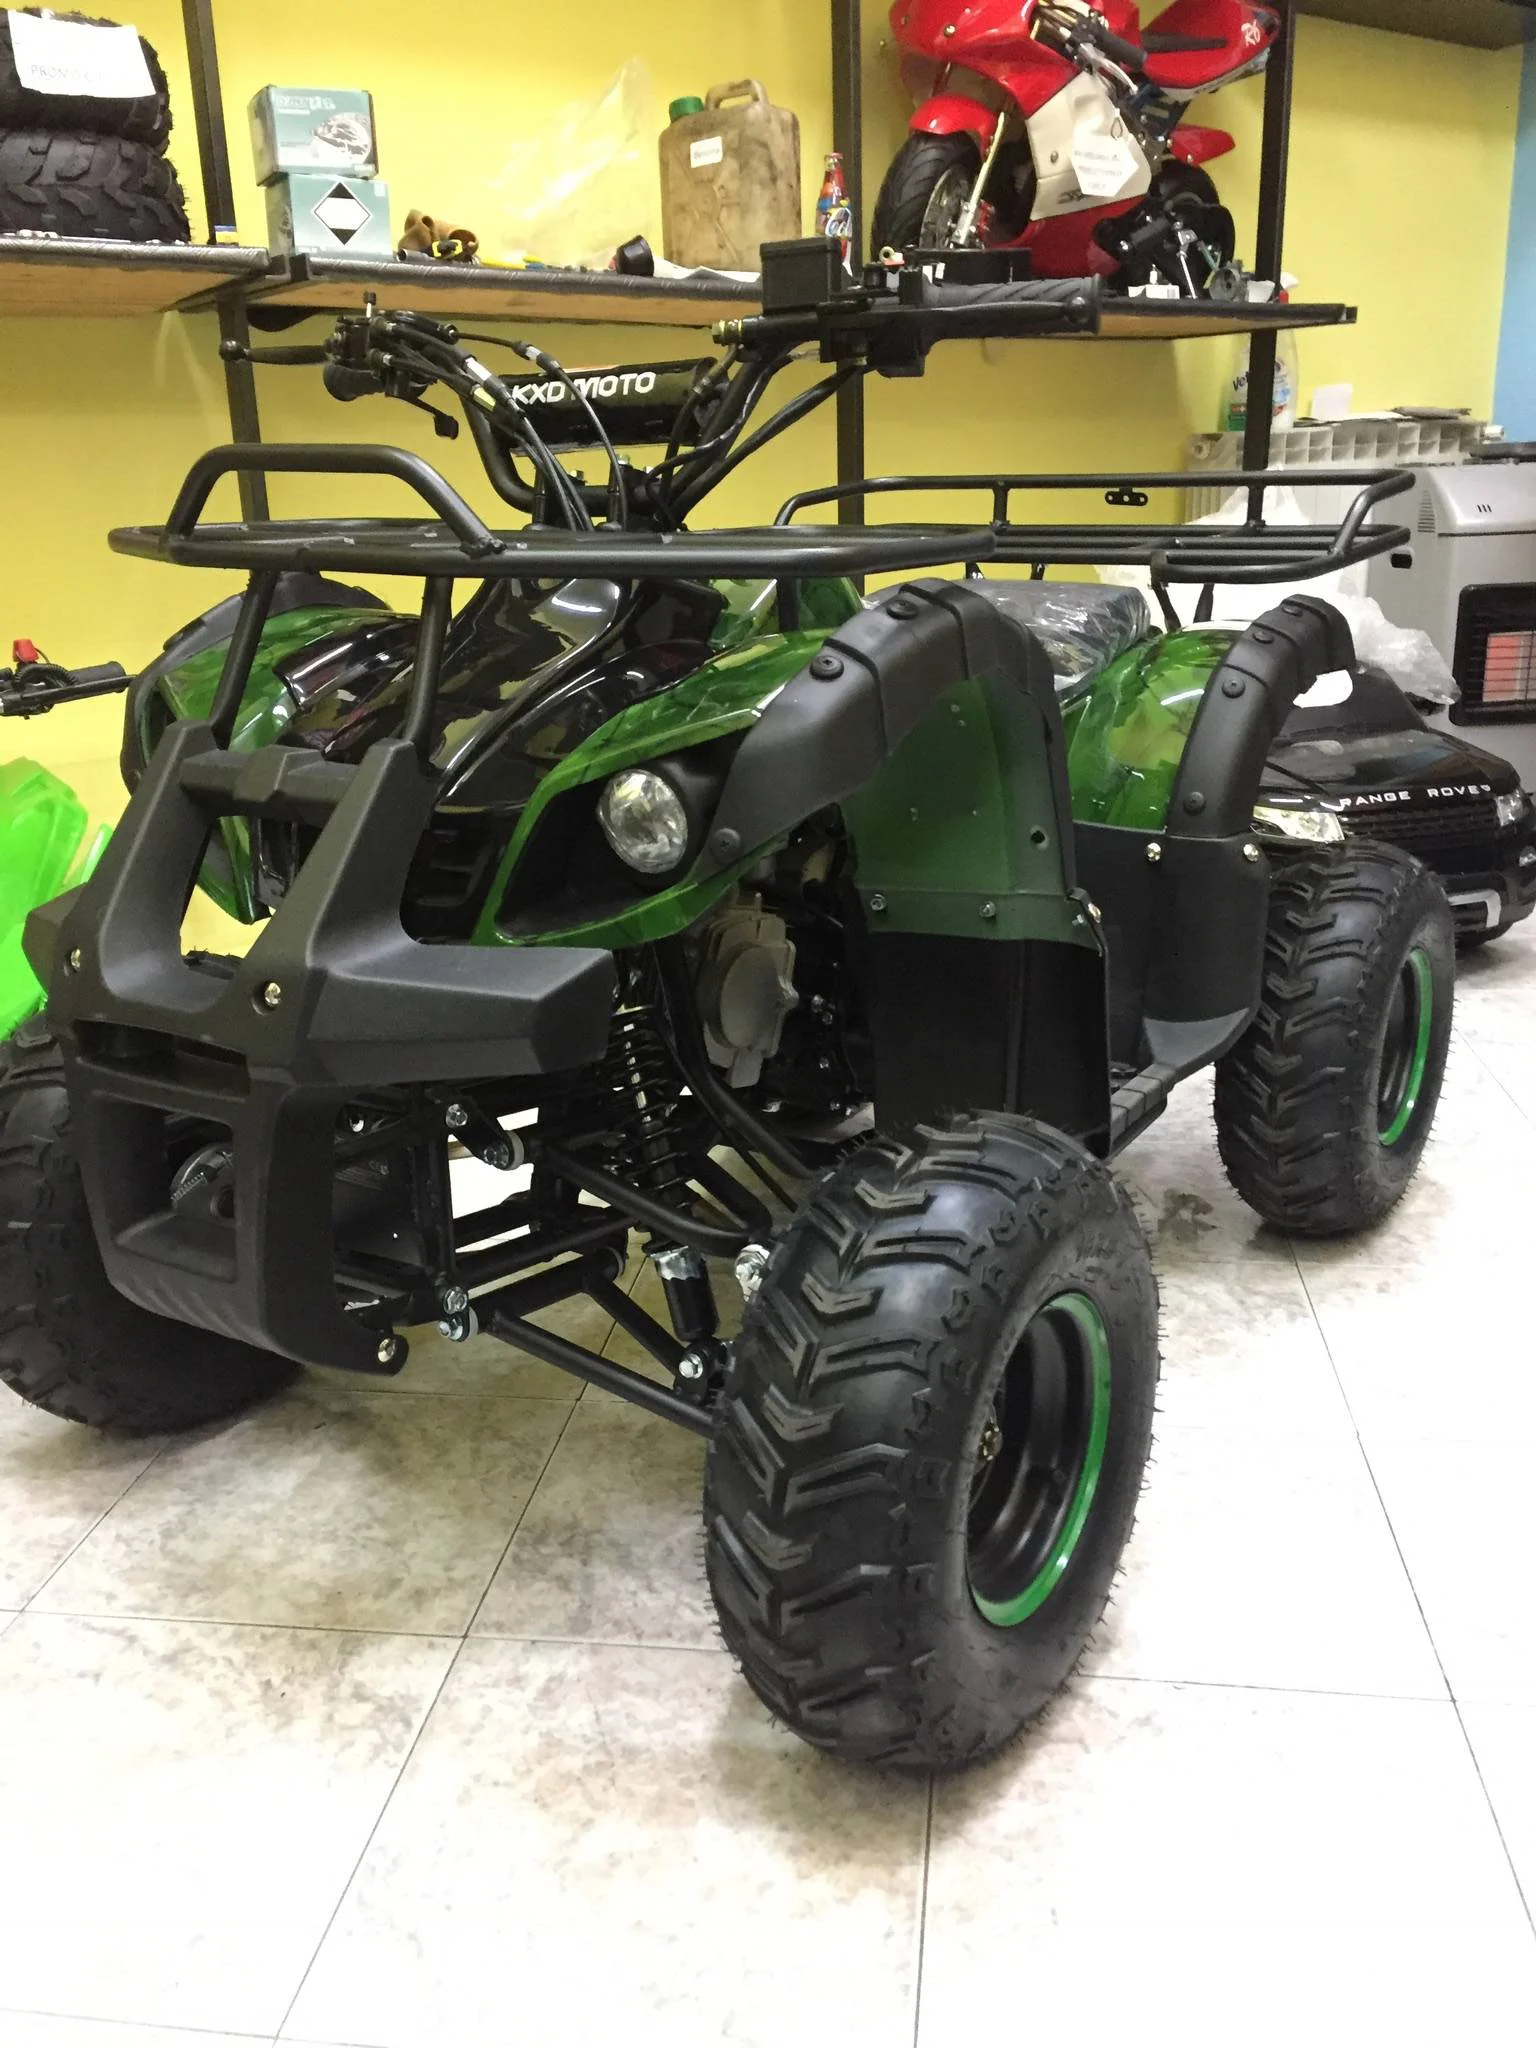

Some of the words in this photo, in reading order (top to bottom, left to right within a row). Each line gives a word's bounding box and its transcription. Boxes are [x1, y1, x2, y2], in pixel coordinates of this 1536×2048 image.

[512, 381, 565, 405] KXD
[571, 371, 656, 401] MOTO
[1338, 790, 1411, 807] RANGE
